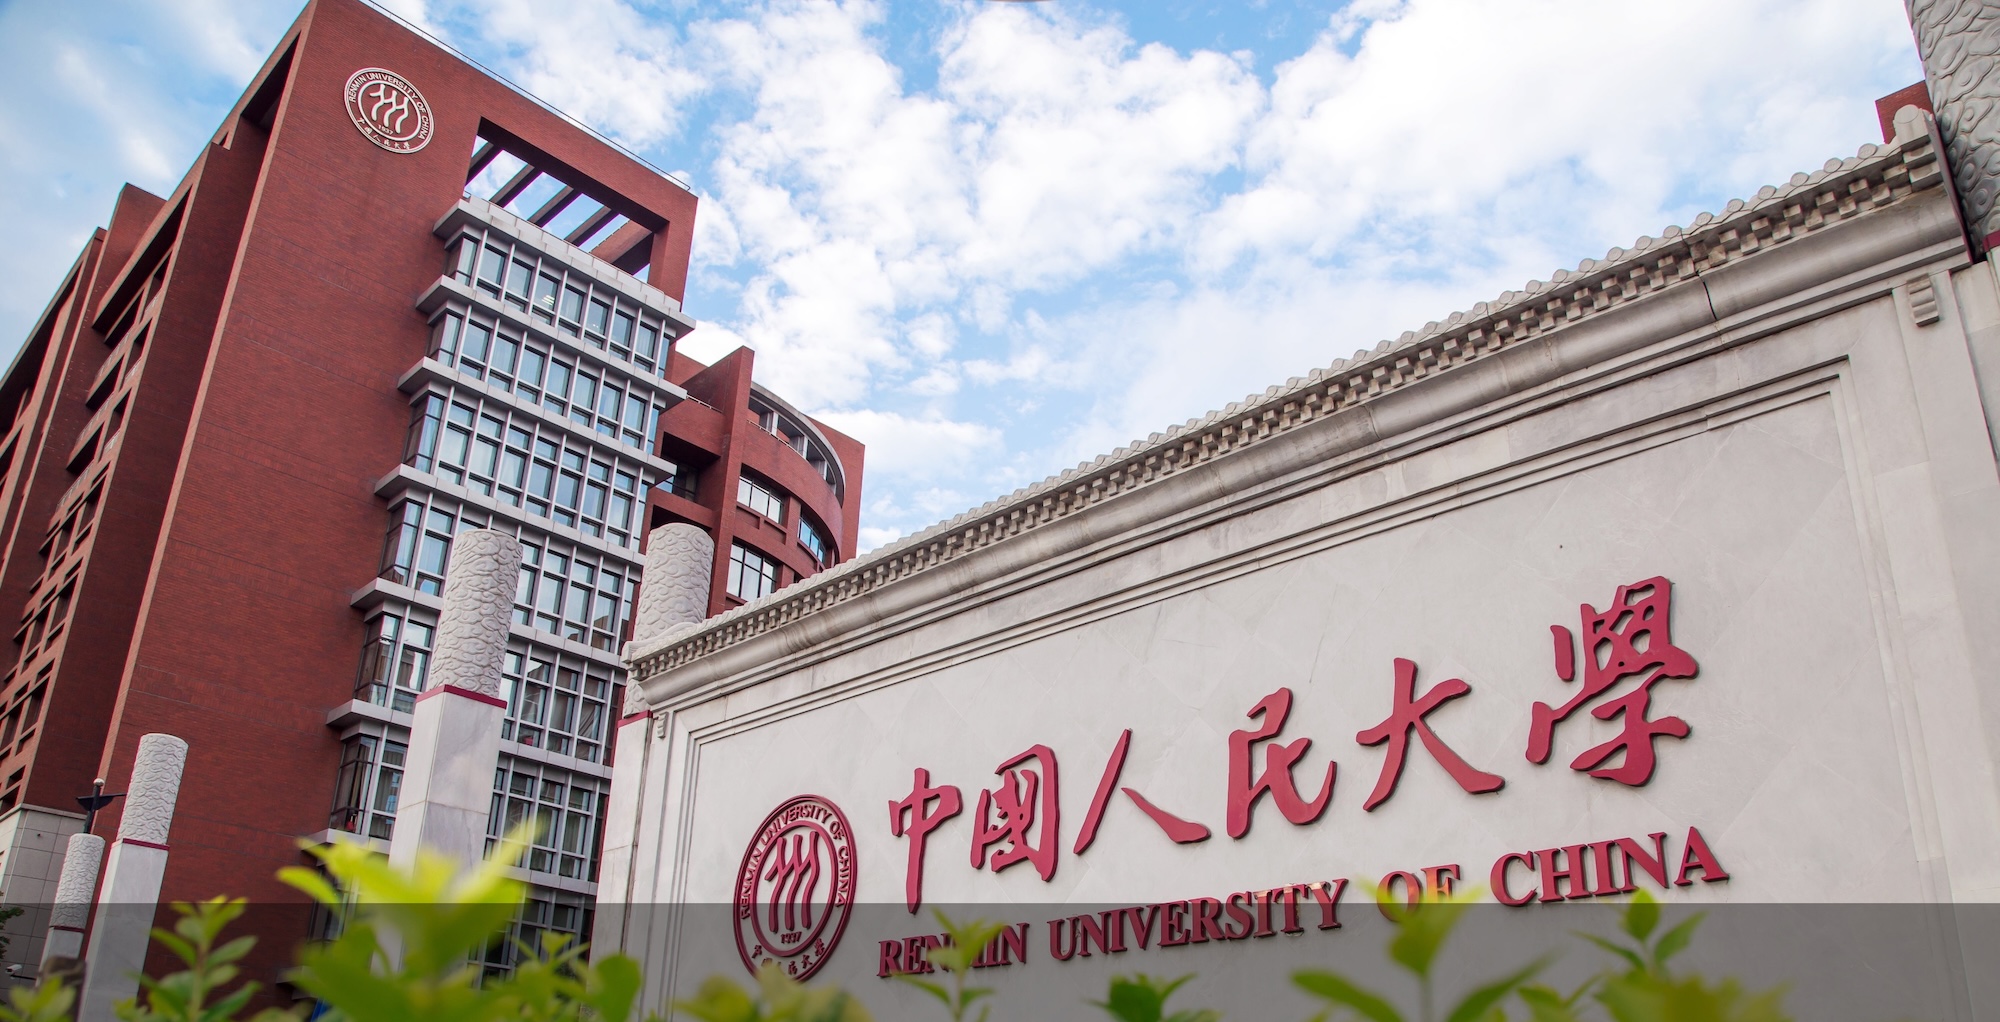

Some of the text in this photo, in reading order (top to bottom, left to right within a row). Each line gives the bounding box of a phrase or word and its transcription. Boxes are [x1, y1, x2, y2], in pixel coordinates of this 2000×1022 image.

[348, 72, 429, 140] RENMIN UNIVERSITY OF CHINA
[378, 125, 394, 135] 1937
[887, 575, 1700, 914] 中國人民大學
[741, 804, 850, 919] RENMIN UNIVERSITY OF CHINA
[1047, 878, 1350, 961] UNIVERSITY
[1376, 864, 1460, 923] OF
[1490, 826, 1730, 908] CHINA
[781, 931, 803, 944] 1937
